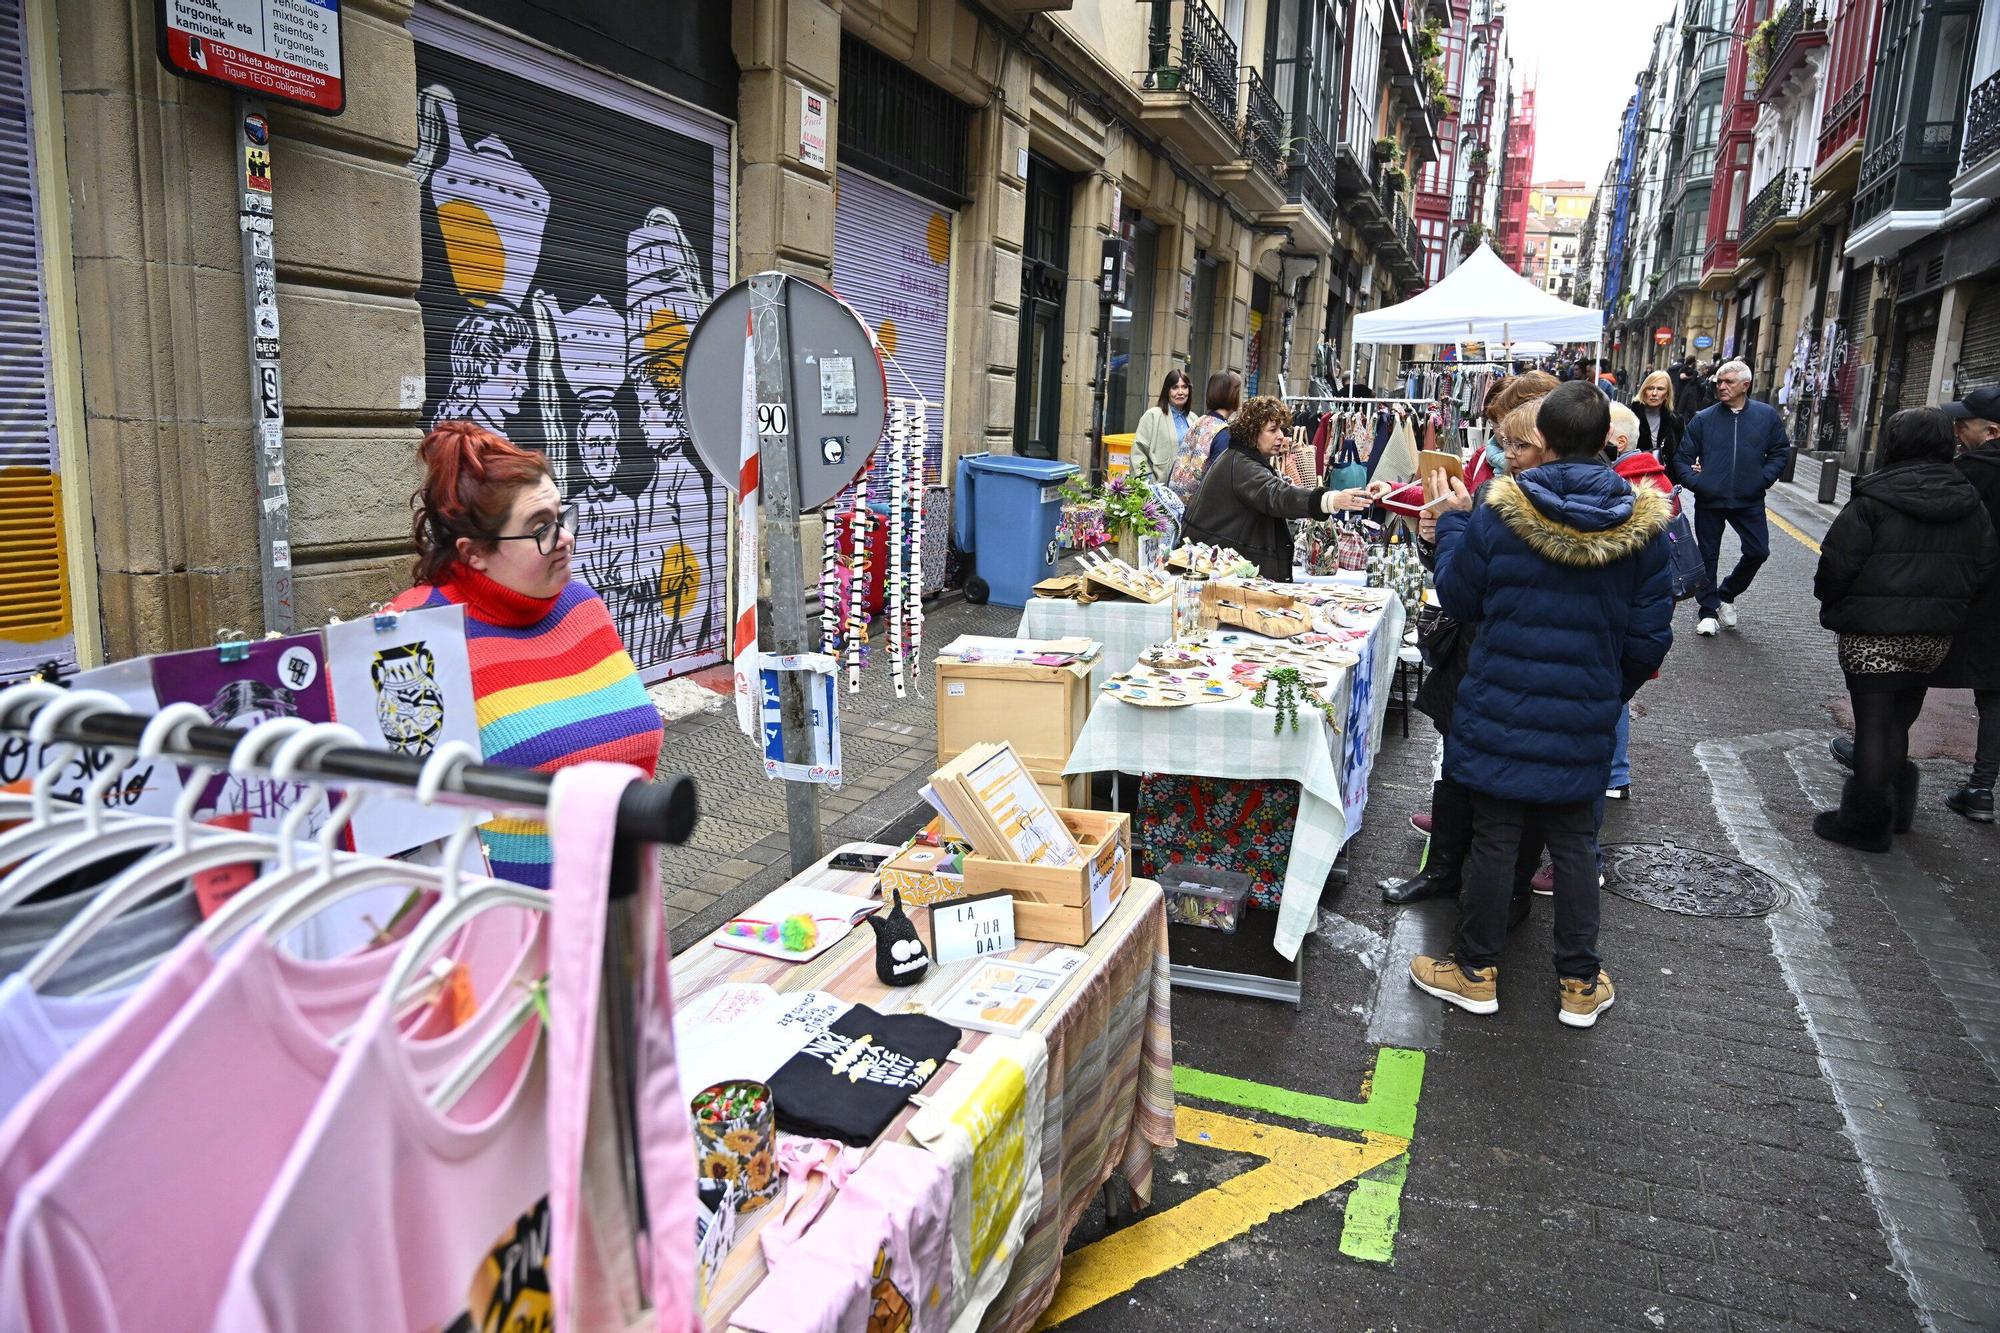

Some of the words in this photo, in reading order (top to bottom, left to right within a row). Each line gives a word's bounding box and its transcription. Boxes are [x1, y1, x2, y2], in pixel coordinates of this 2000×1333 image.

[175, 1, 235, 30] furgonetak
[236, 22, 253, 36] eta
[176, 14, 226, 40] kamioiak
[272, 9, 304, 26] mixtos
[307, 20, 319, 31] de
[321, 23, 328, 35] 2
[273, 22, 314, 42] asientos
[273, 33, 326, 58] furgonetas
[210, 43, 236, 60] TECD
[238, 52, 263, 68] tiketa
[265, 60, 326, 87] derrigorrezkoa
[274, 48, 281, 58] y
[283, 51, 329, 72] camiones
[223, 64, 247, 80] Tique
[249, 73, 274, 88] TECD
[275, 81, 316, 99] obligatorio
[757, 404, 787, 434] 90
[957, 906, 975, 923] LA
[976, 935, 1002, 954] DA!
